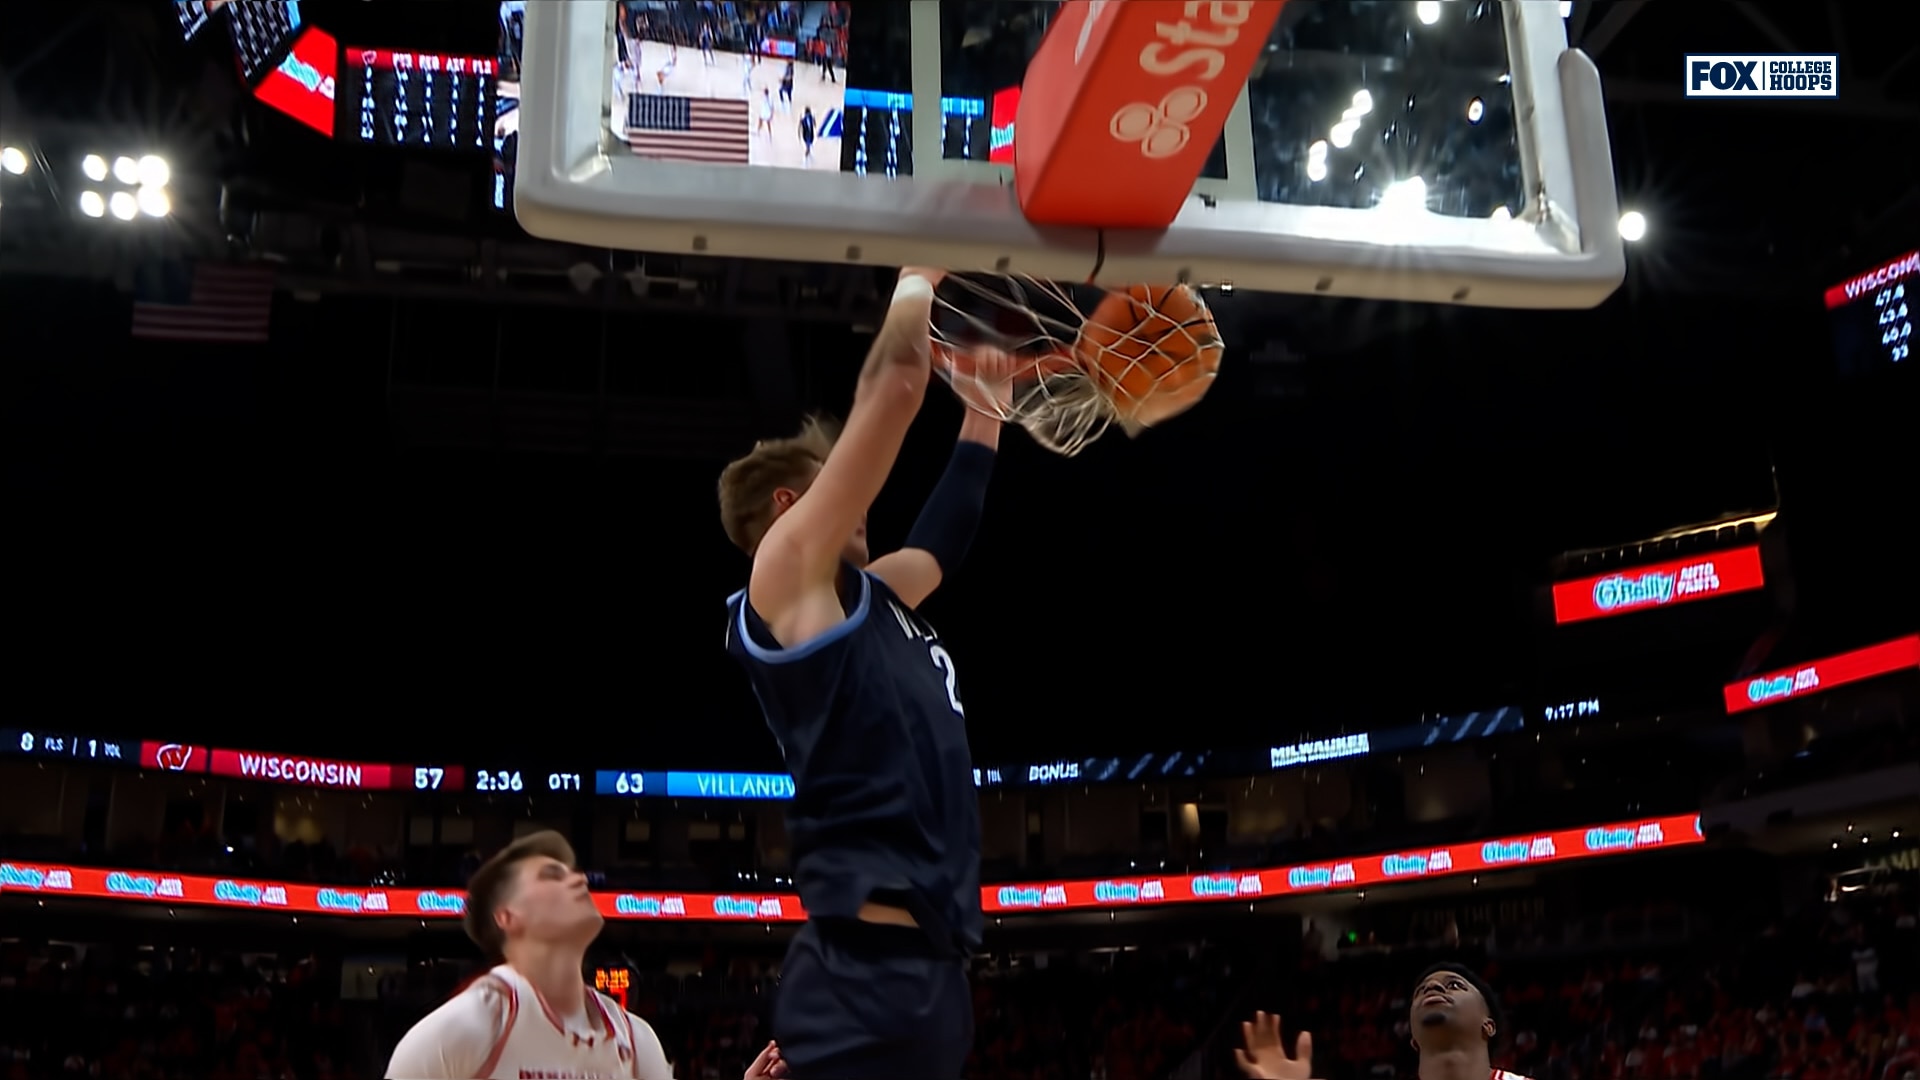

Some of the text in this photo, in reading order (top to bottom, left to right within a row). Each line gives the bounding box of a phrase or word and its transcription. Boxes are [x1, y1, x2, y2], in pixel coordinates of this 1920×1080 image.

[21, 732, 34, 751] 8
[239, 753, 362, 786] WISCONSIN
[414, 768, 444, 790] 57
[476, 770, 523, 791] 2:36
[548, 773, 581, 791] OT1
[616, 772, 645, 794] 63
[1029, 762, 1079, 781] BONUS
